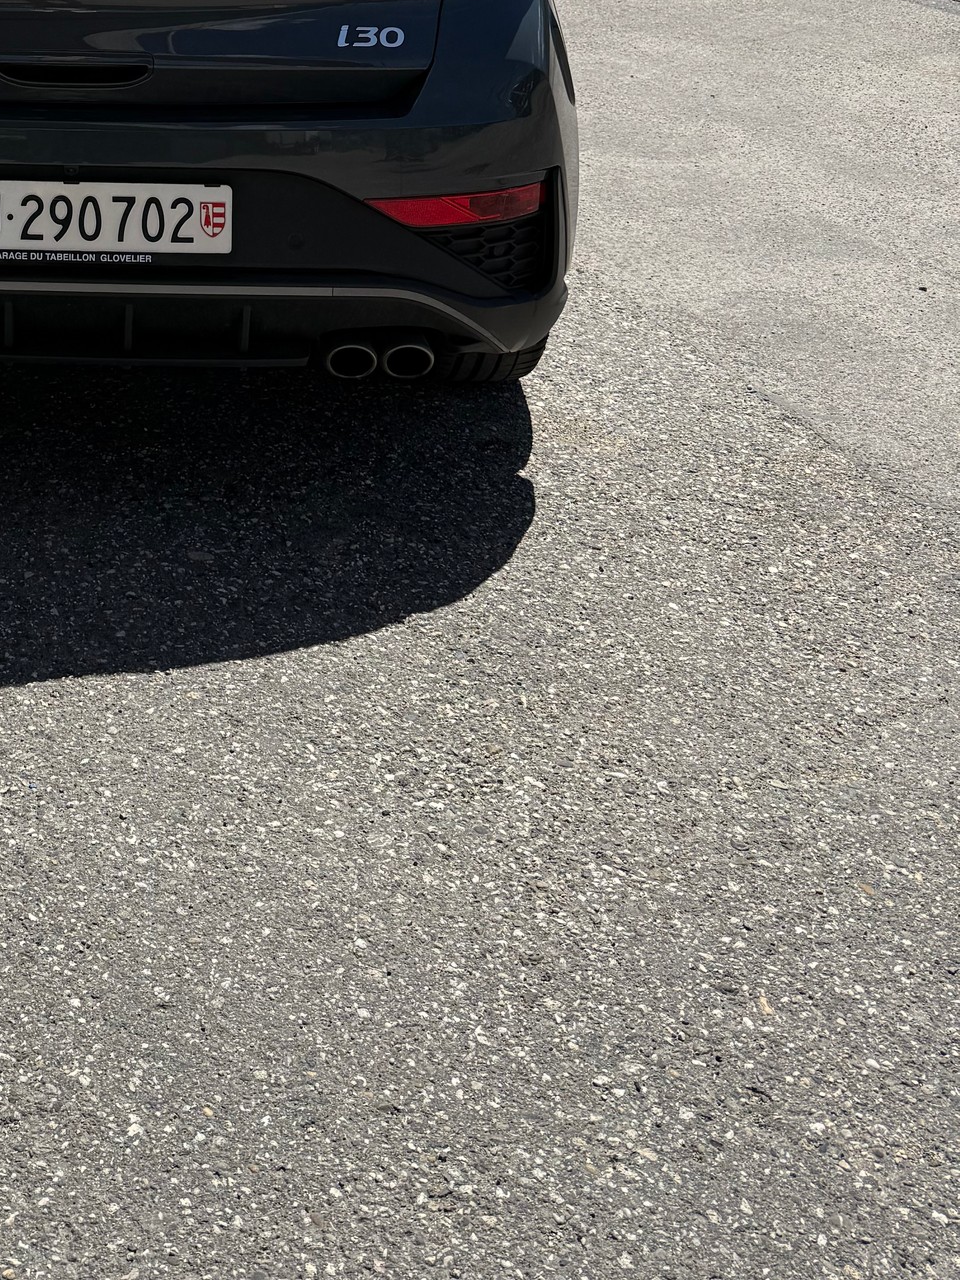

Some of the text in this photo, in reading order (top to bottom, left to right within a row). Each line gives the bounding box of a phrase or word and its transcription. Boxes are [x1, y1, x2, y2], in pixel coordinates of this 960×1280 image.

[29, 252, 43, 261] DU
[45, 253, 96, 262] TABEILLON
[100, 254, 152, 263] GLOVELIER
